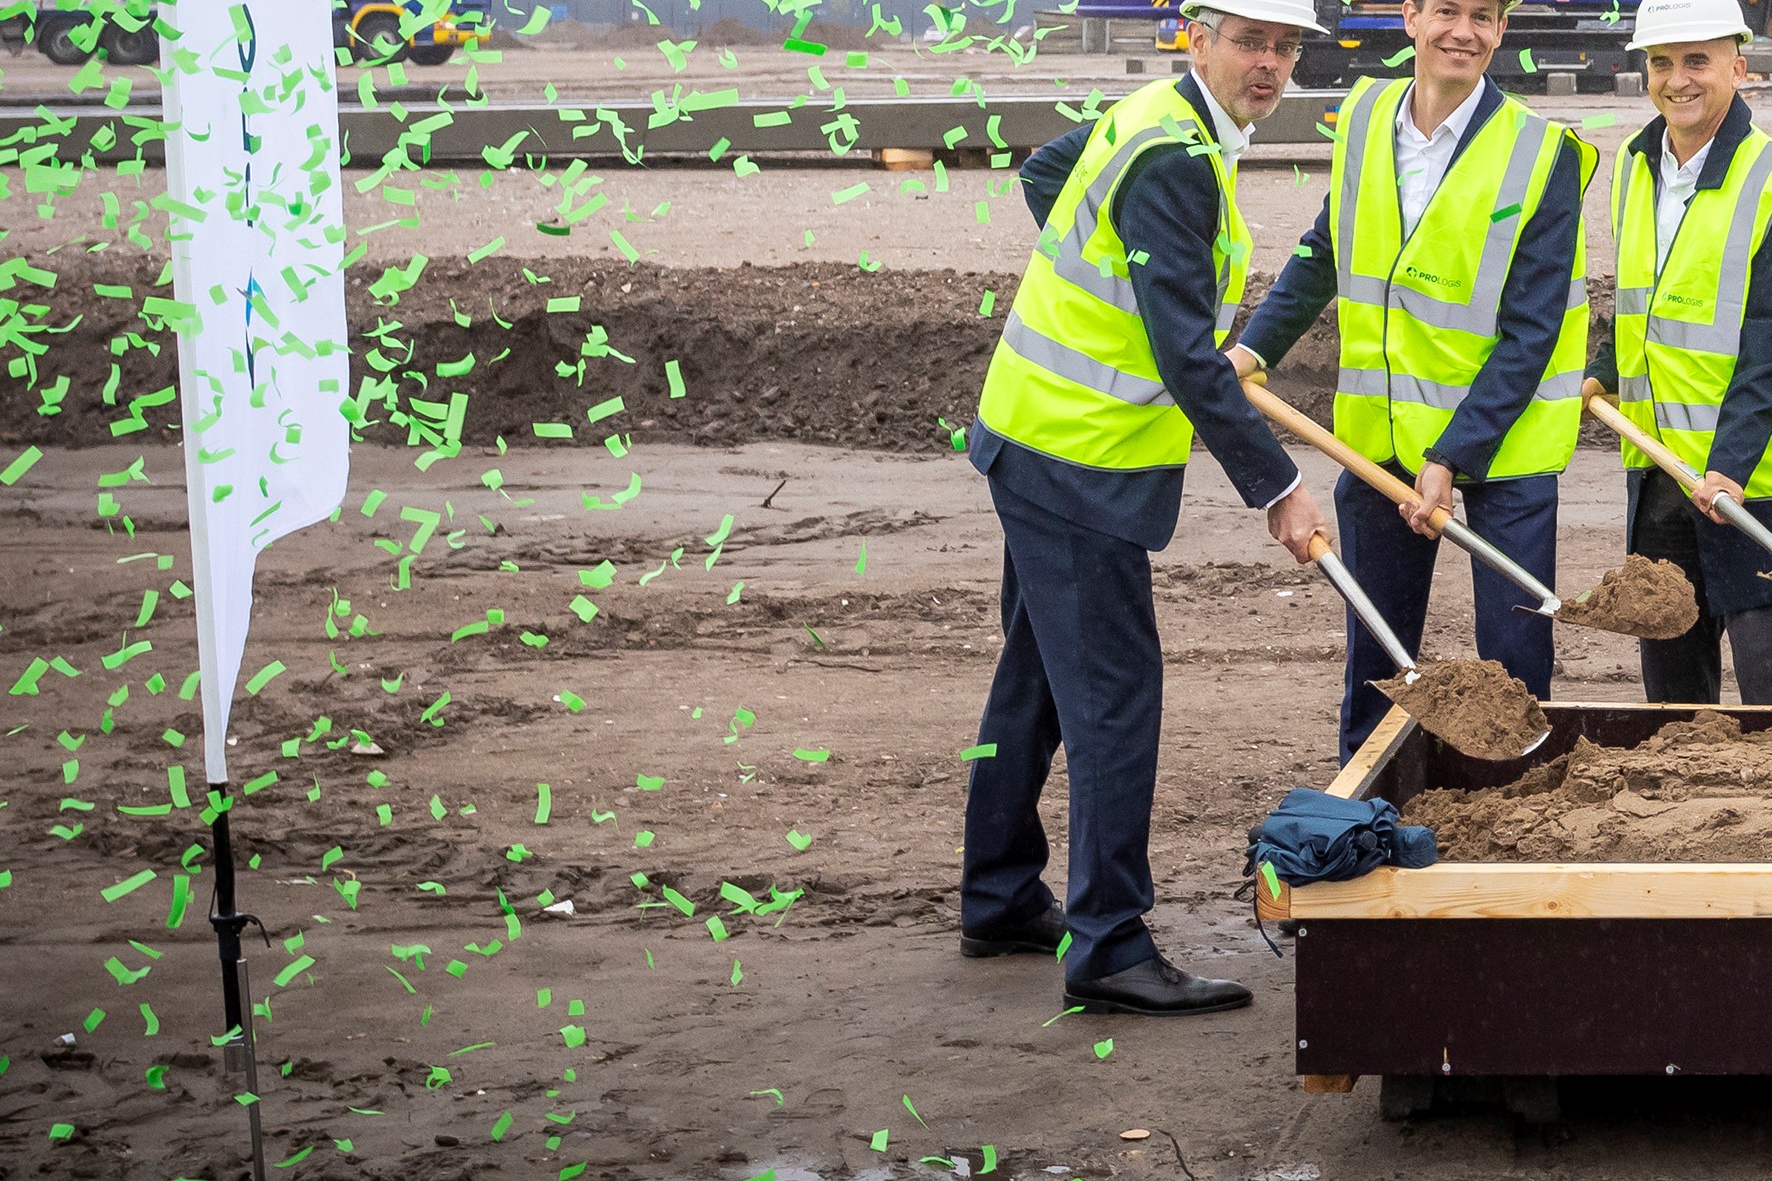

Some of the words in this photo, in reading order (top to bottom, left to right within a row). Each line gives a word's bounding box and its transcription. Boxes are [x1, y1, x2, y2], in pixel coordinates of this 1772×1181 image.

[1655, 1, 1692, 12] PROLOGIS
[1418, 271, 1462, 288] PROLOGIS
[1667, 294, 1704, 308] PROLOGIS
